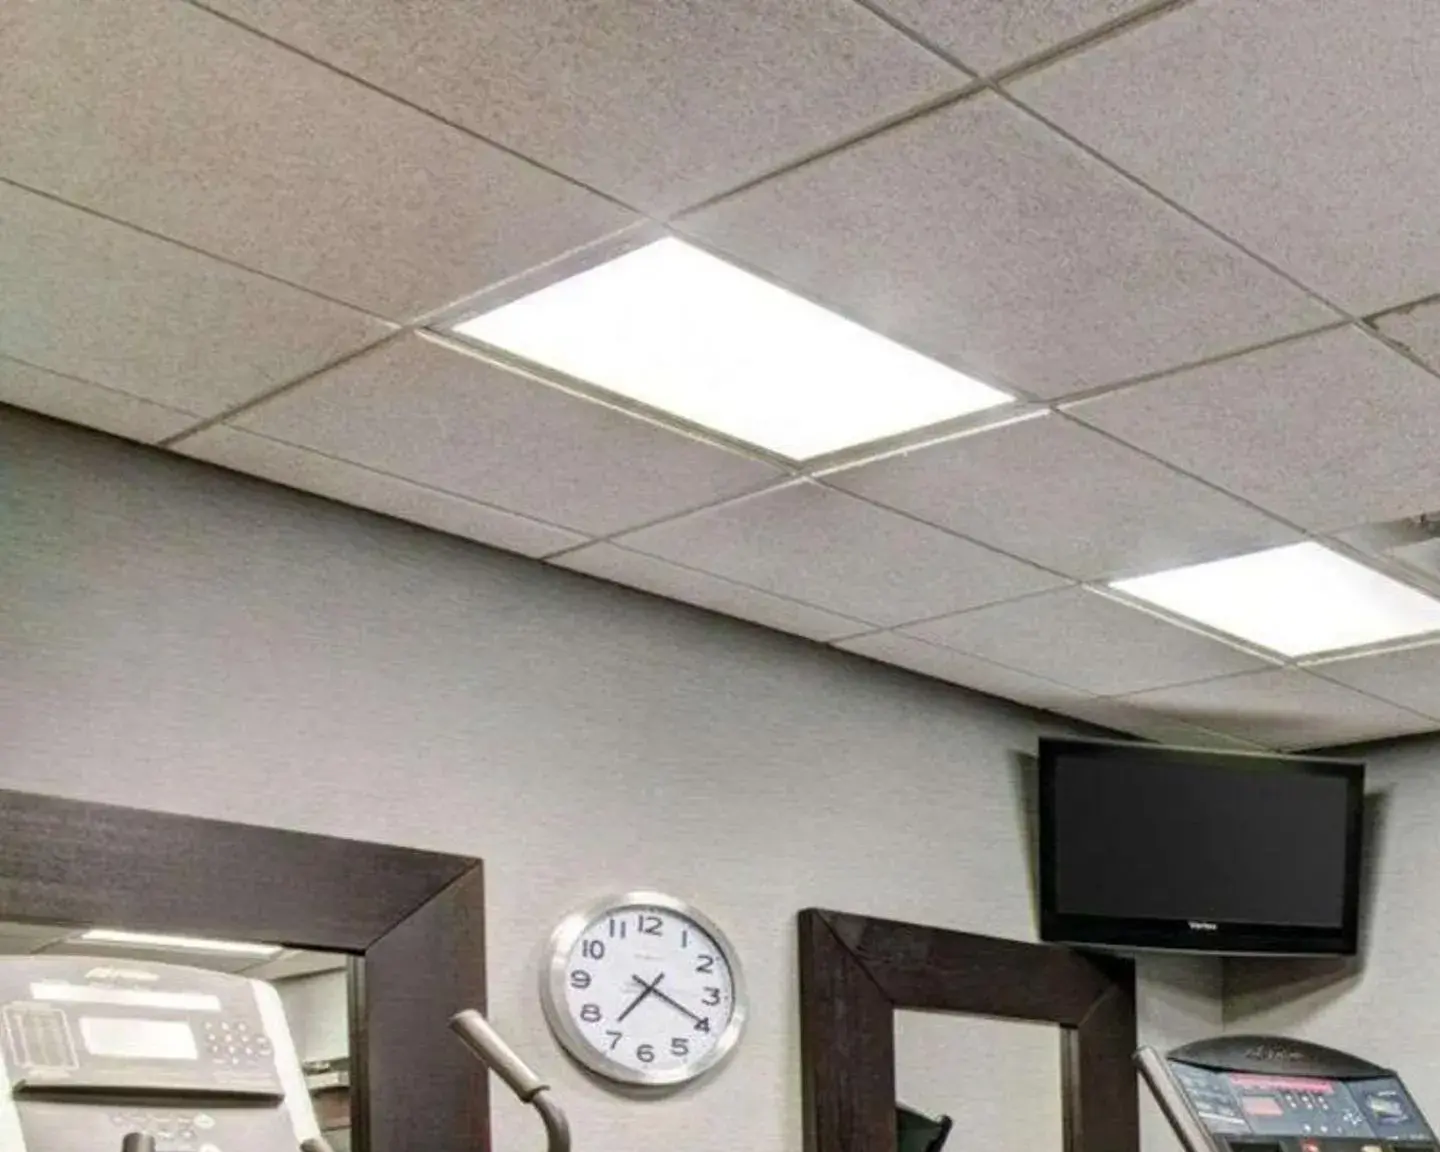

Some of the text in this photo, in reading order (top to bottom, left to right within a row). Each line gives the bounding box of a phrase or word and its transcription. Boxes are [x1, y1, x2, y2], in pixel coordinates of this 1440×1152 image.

[609, 919, 626, 939] 11
[637, 915, 663, 936] 12
[681, 930, 688, 948] 1
[581, 939, 605, 960] 10
[695, 955, 714, 973] 2
[570, 969, 591, 989] 9
[702, 987, 721, 1006] 3
[580, 1003, 602, 1022] 8
[694, 1016, 711, 1034] 4
[605, 1031, 623, 1050] 7
[671, 1037, 689, 1056] 5
[636, 1044, 655, 1063] 6
